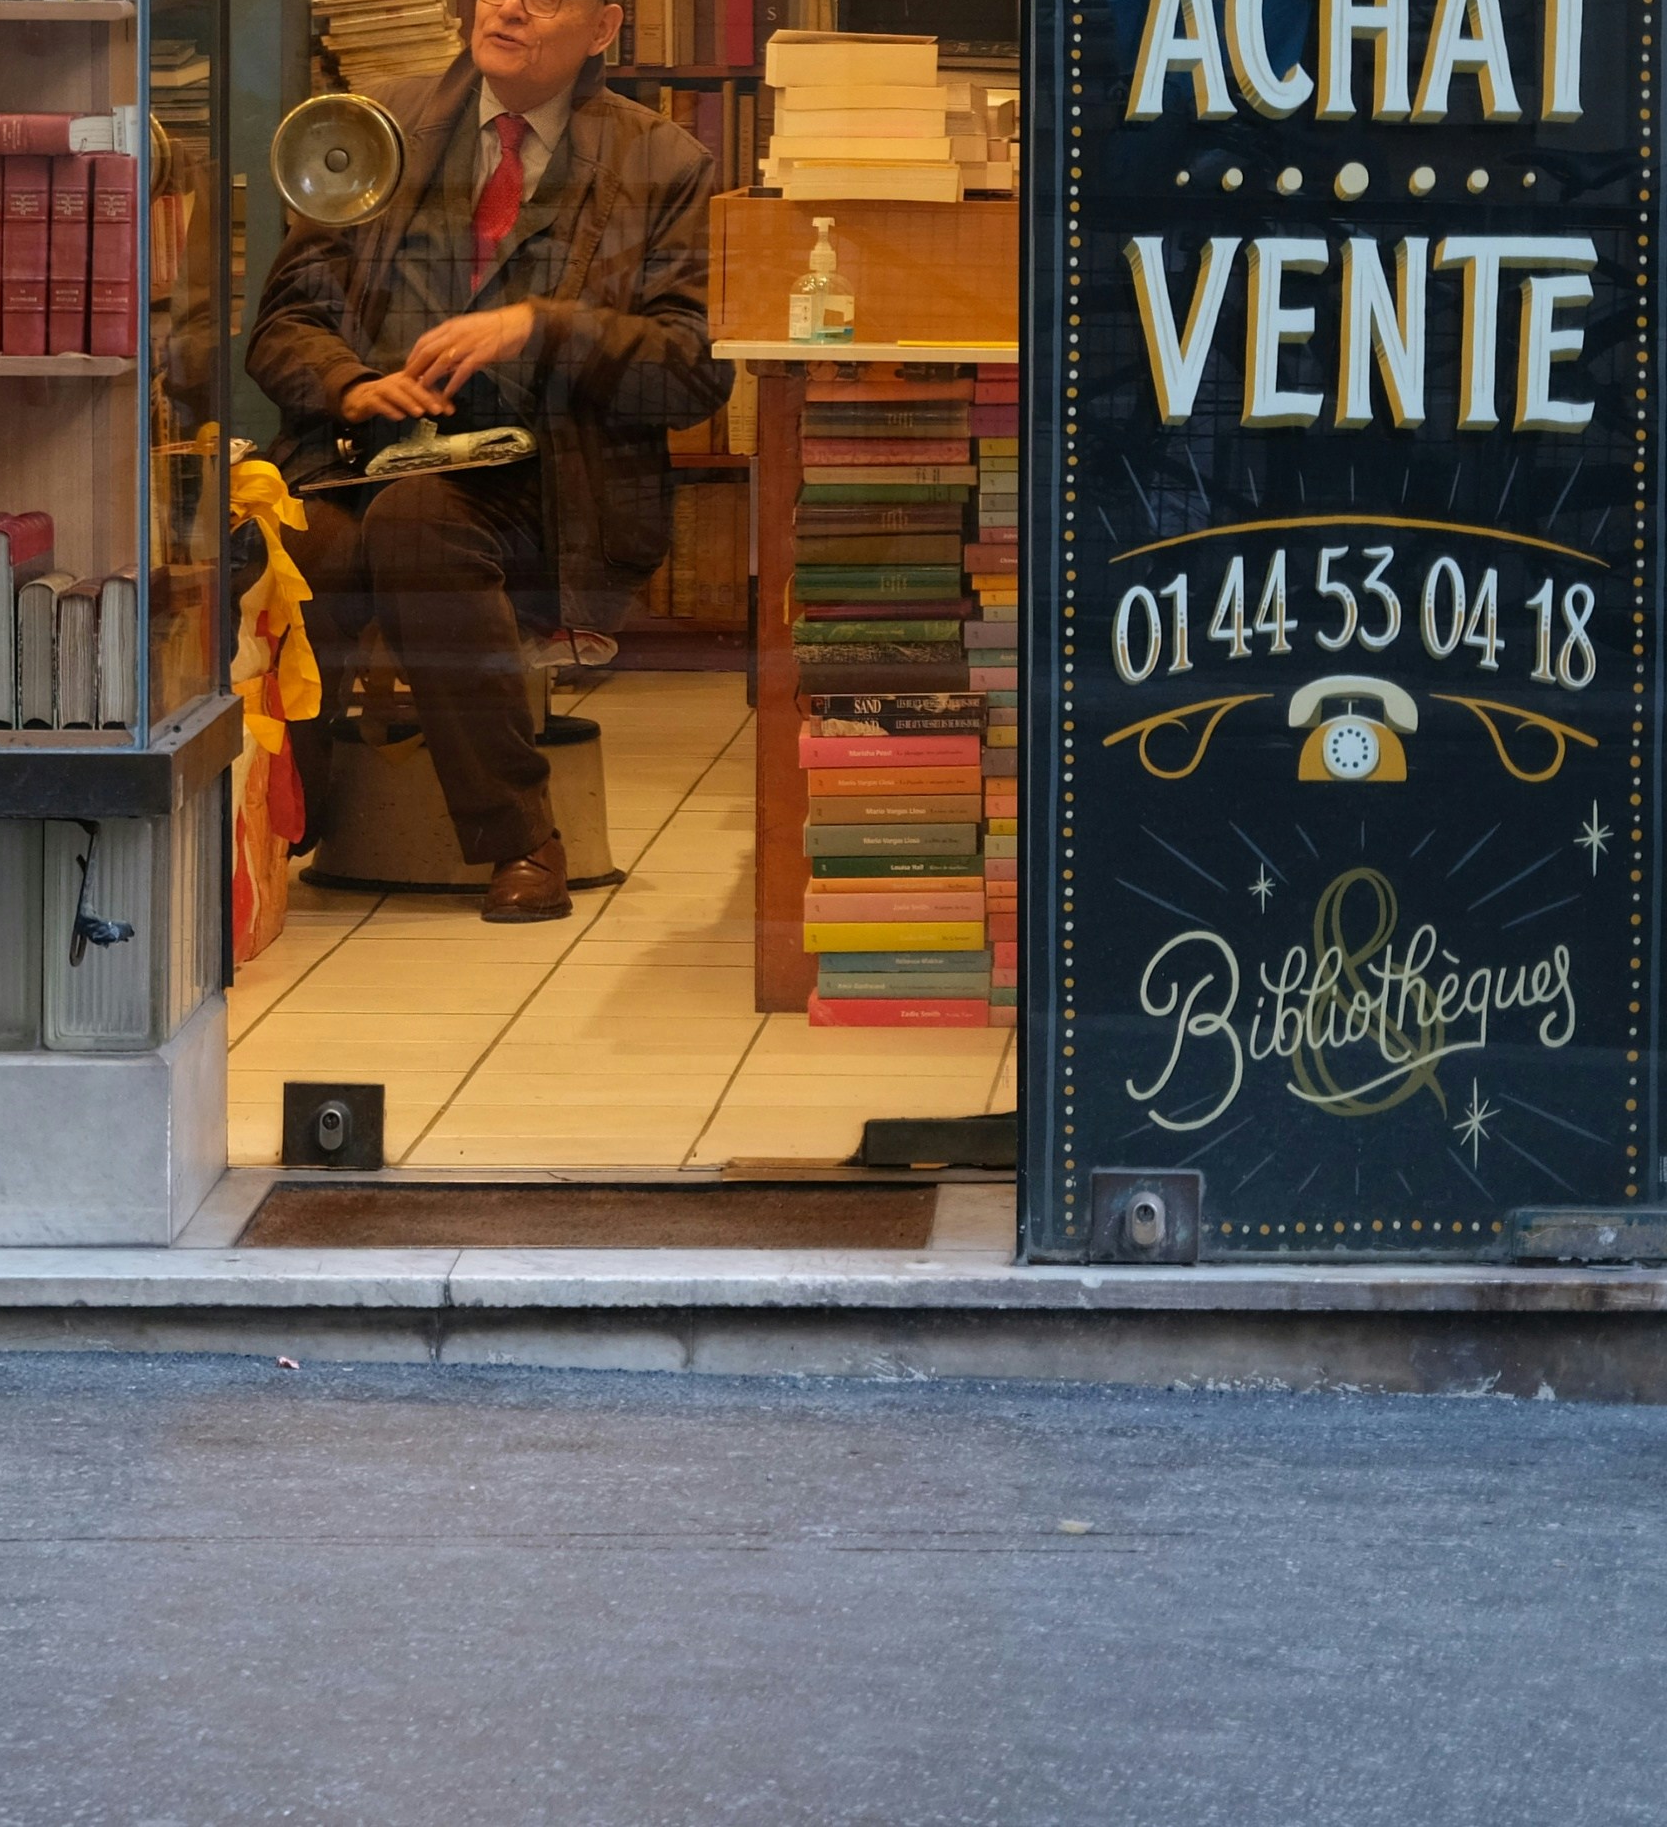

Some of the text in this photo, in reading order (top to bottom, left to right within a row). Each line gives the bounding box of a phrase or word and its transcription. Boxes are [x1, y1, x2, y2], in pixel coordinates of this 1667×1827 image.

[1123, 236, 1598, 433] VENTE
[1113, 546, 1596, 690] 01 44 53 04 18
[854, 699, 881, 714] SAND
[1126, 924, 1575, 1131] Bibliothèques
